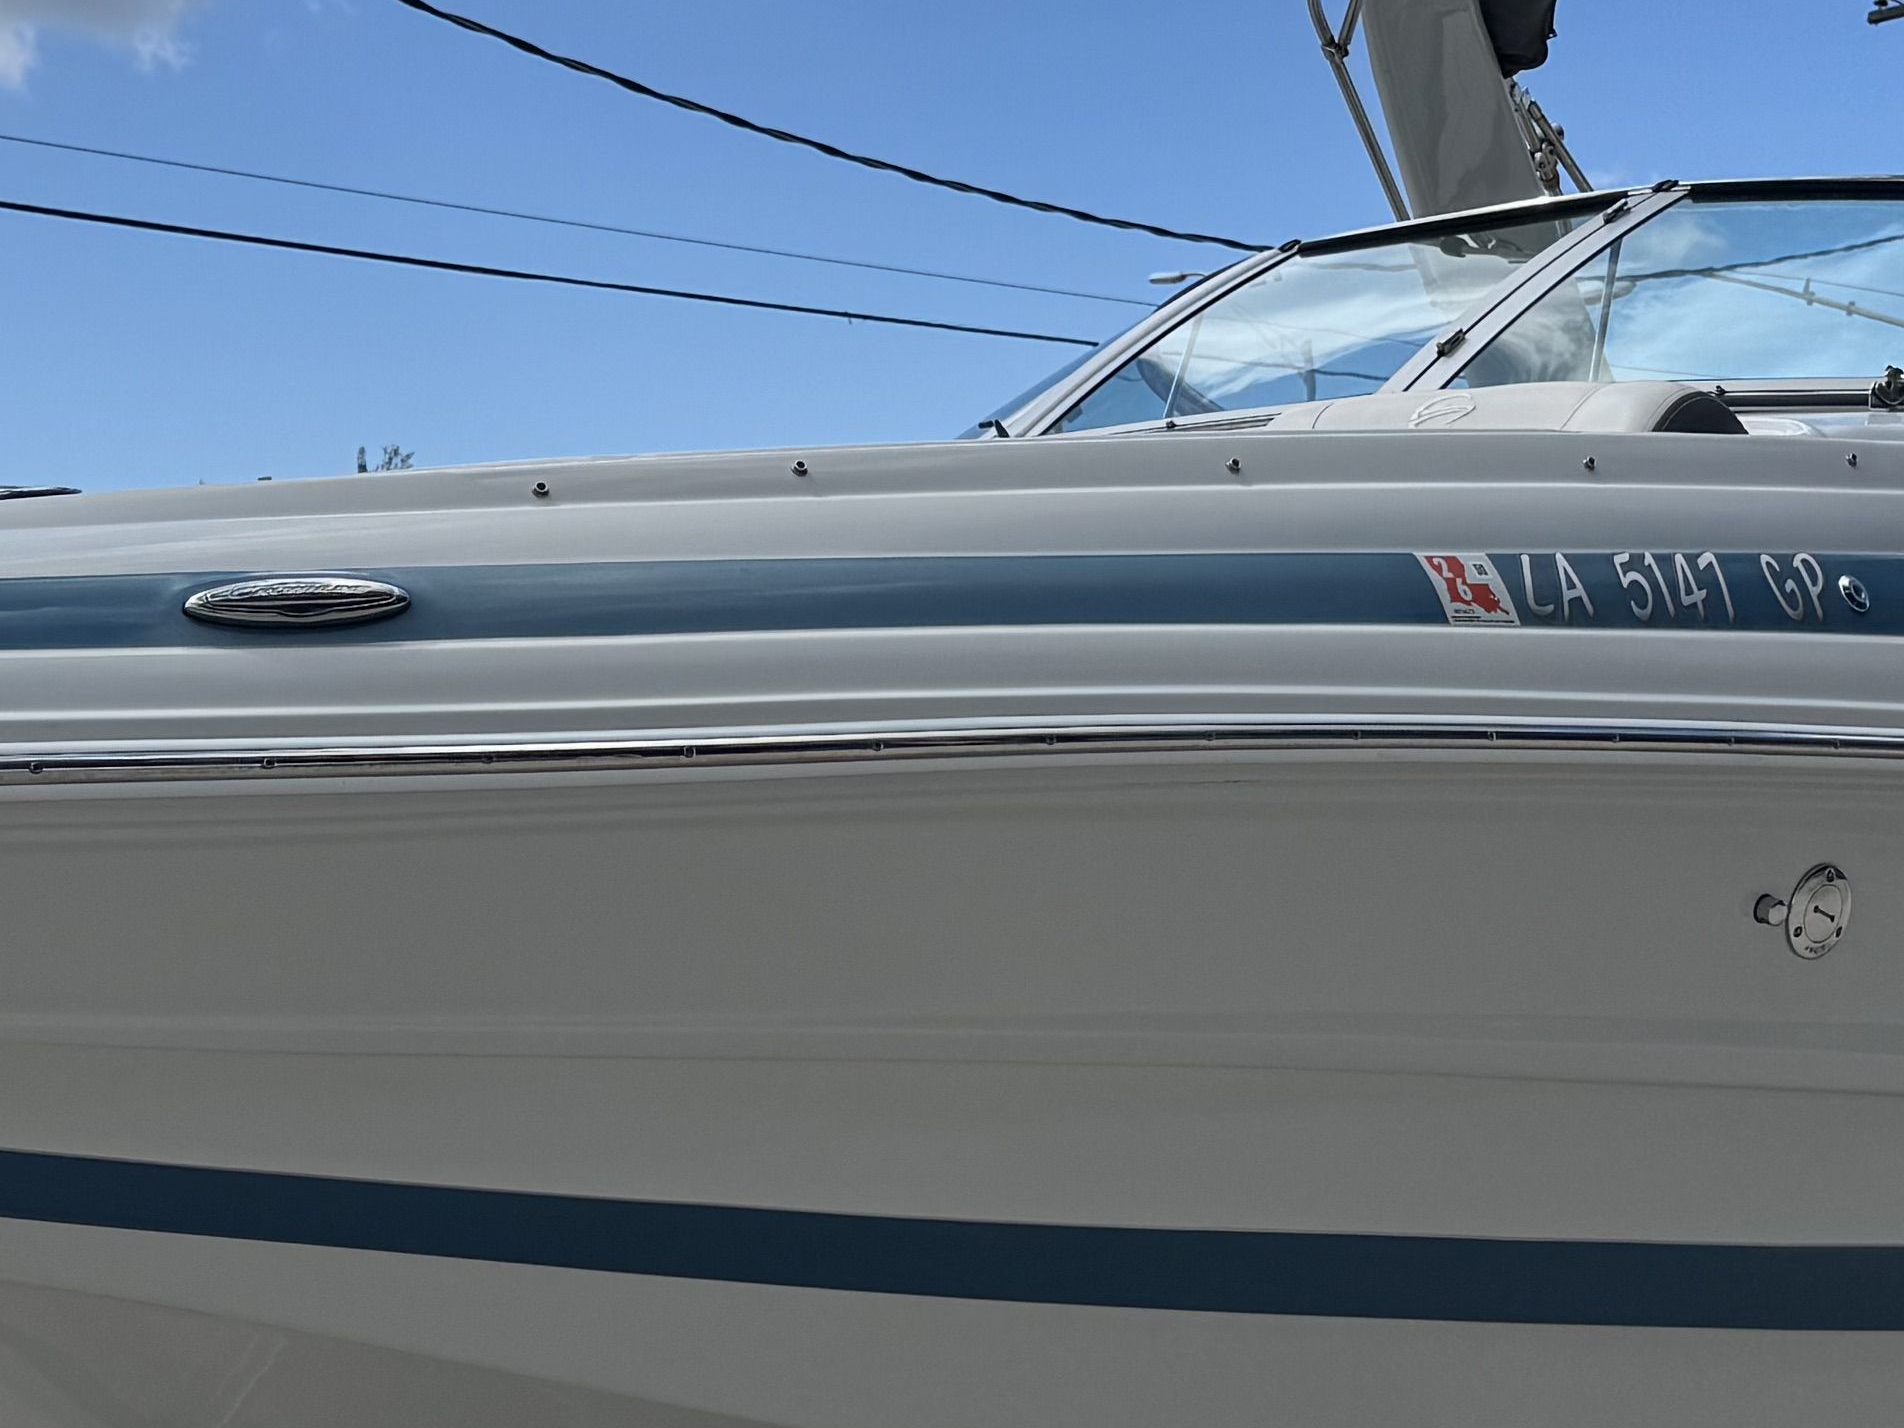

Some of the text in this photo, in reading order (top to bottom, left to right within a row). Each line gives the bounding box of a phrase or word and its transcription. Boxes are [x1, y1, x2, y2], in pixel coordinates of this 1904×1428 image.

[1519, 550, 1824, 623] LA 5147 GP
